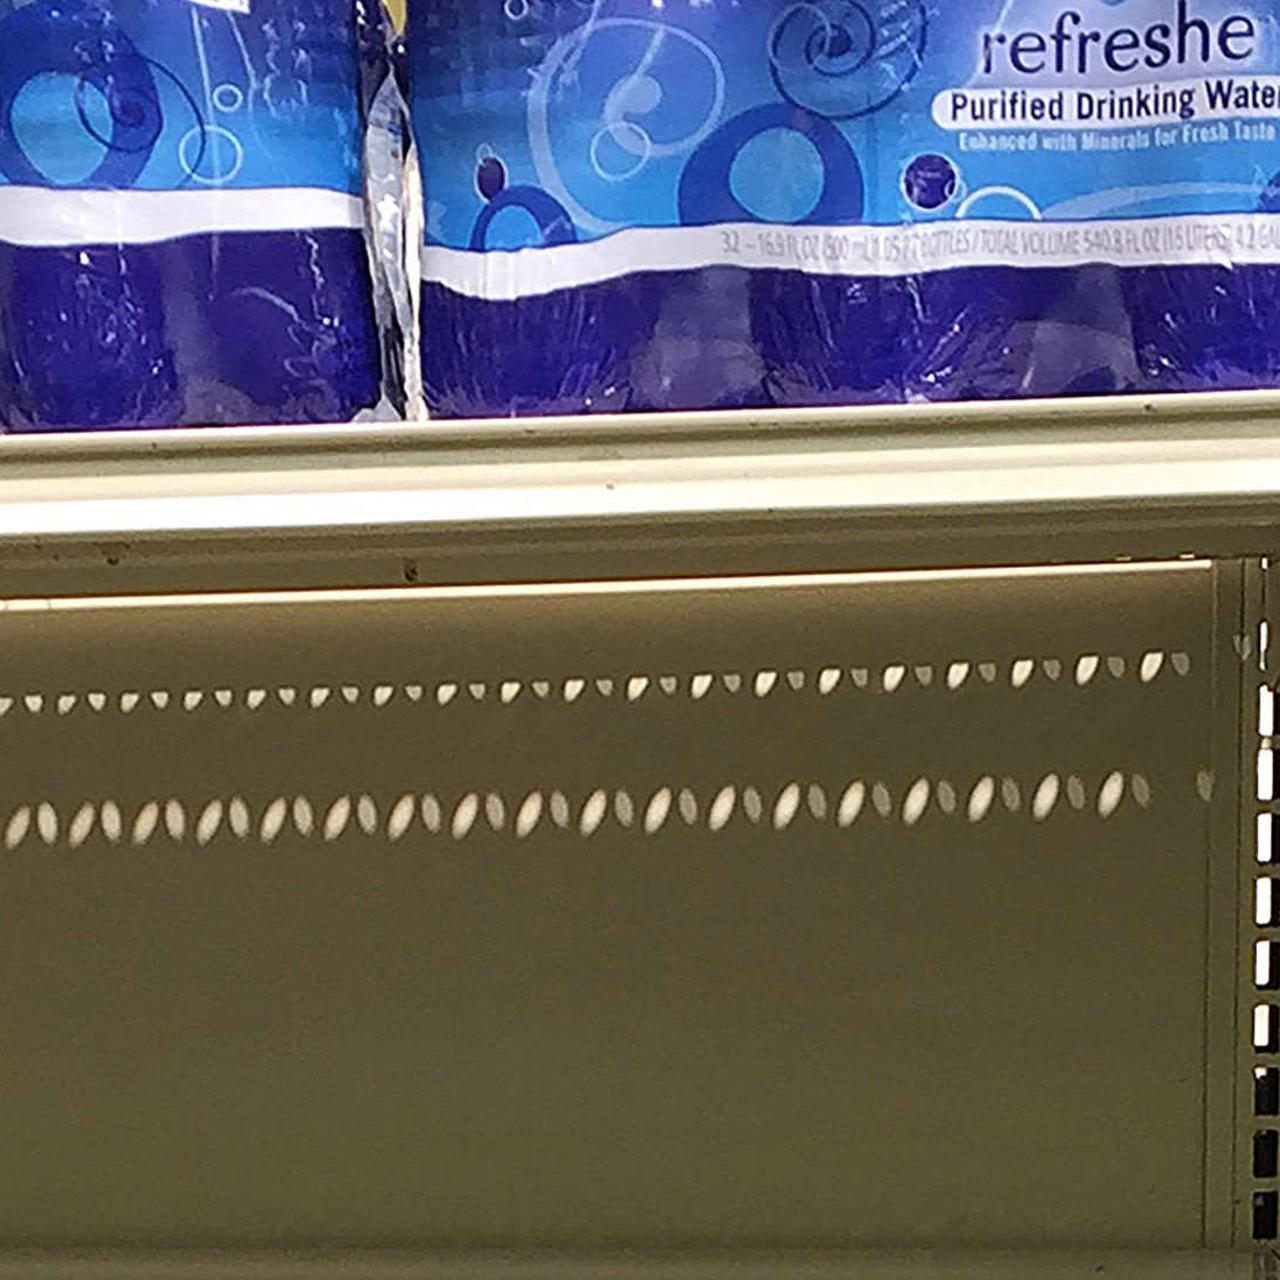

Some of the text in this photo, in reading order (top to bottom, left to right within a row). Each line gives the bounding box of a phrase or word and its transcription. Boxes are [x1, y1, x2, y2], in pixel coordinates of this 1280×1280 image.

[983, 0, 1255, 74] refreshe
[951, 90, 1064, 121] Purified
[1076, 80, 1196, 120] Drinking
[958, 121, 1277, 151] Enhanced with Minerals for Fresh Taste
